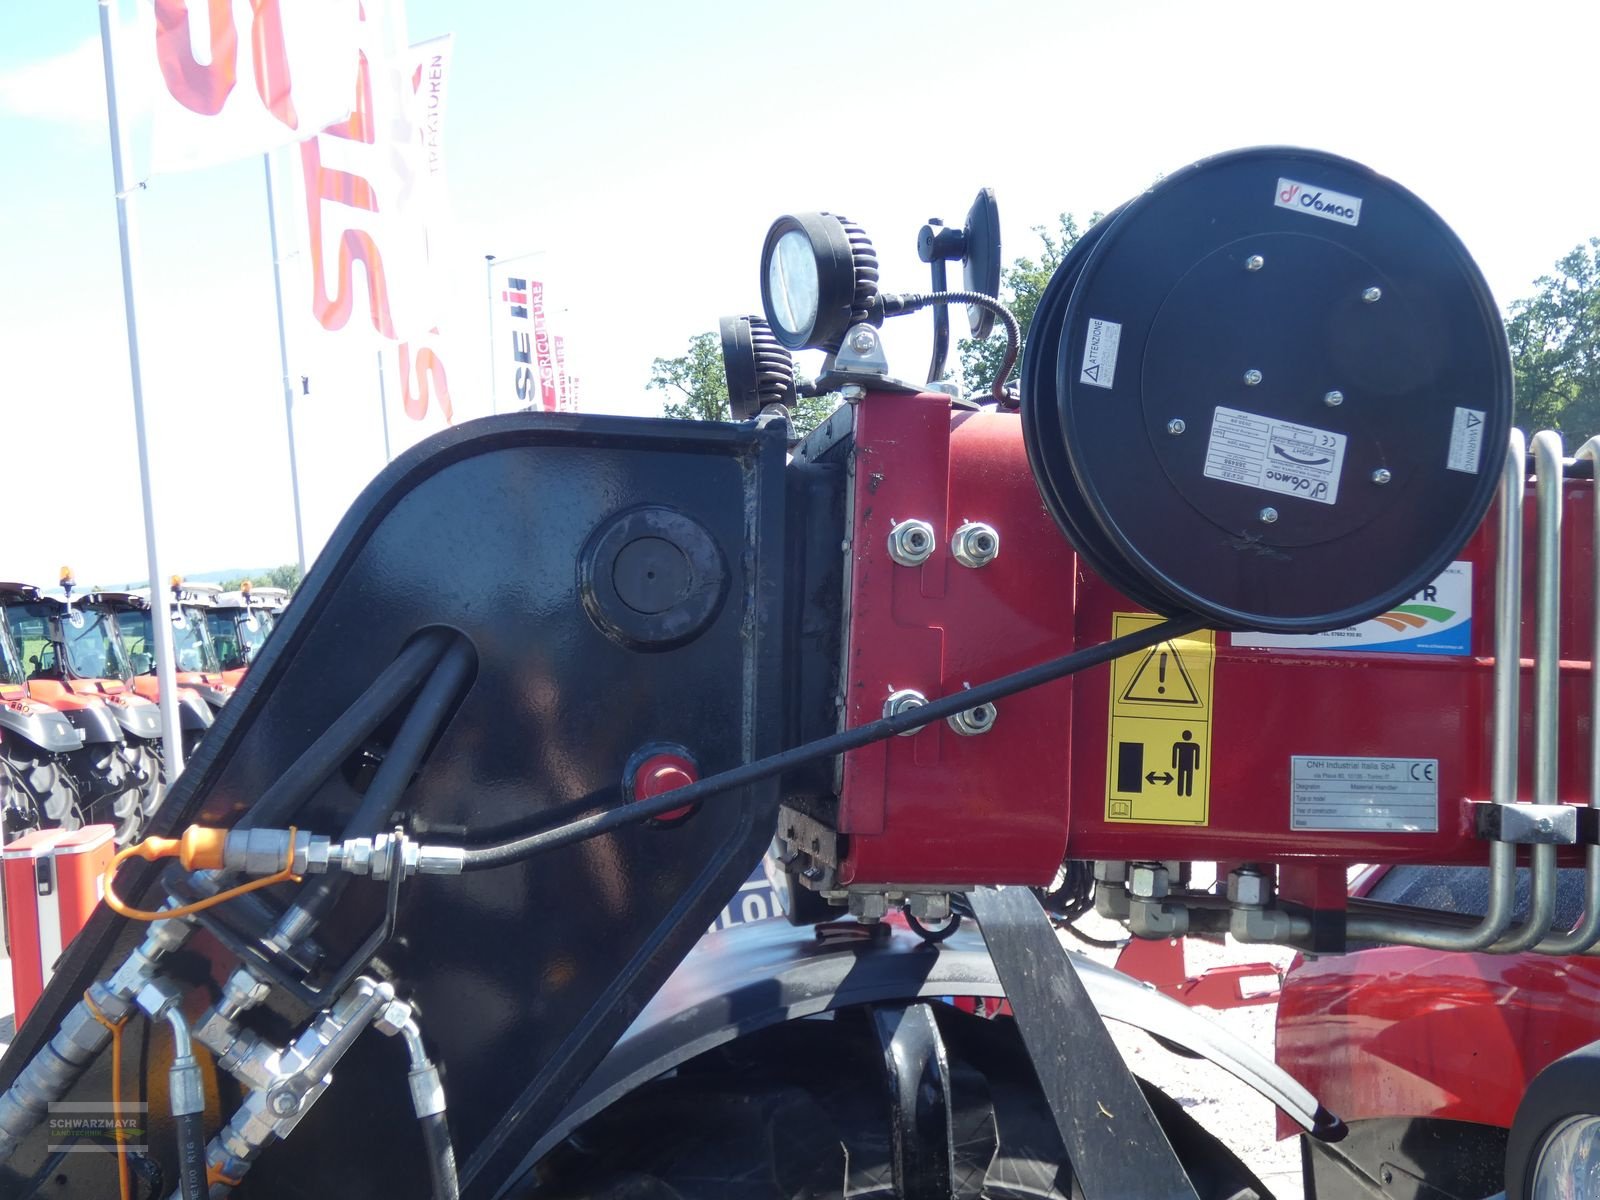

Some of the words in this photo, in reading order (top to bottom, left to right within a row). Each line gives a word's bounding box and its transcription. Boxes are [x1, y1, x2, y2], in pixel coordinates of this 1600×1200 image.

[532, 281, 553, 390] AGRICULTURE
[1089, 321, 1103, 364] ATTENZIONE
[1292, 447, 1314, 456] RIGHT
[1464, 428, 1479, 470] WARNING
[1307, 761, 1324, 769] CNH
[1381, 763, 1396, 771] SpA
